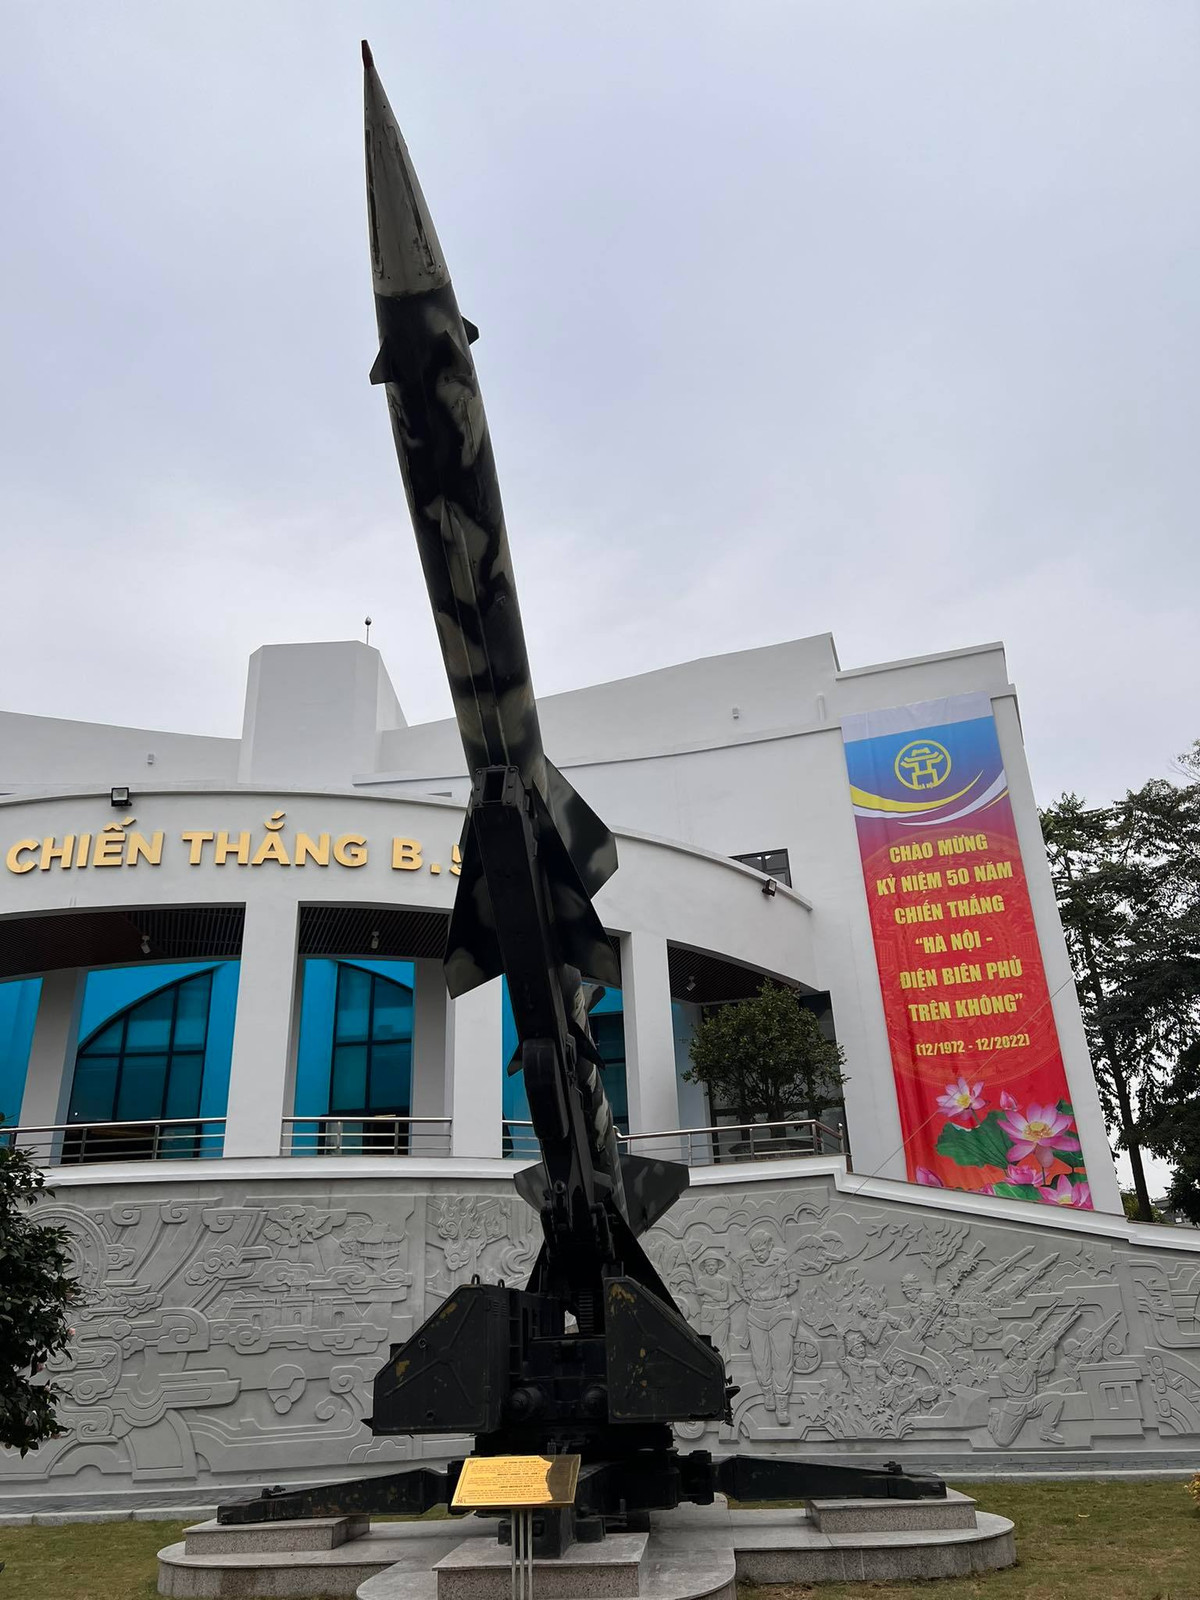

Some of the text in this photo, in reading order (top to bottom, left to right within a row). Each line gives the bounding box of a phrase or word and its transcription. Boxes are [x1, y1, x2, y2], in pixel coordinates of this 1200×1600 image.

[6, 817, 164, 875] CHIẾN
[182, 811, 368, 868] THẮNG
[889, 834, 988, 863] CHÀO MỪNG
[876, 861, 1013, 896] KỶ NIỆM 50 NĂM
[894, 893, 1005, 925] CHIẾN THẮNG
[950, 929, 981, 952] NỘI
[899, 955, 1023, 991] ĐIỆN BIÊN PHỦ
[908, 1000, 951, 1021] TRÊN
